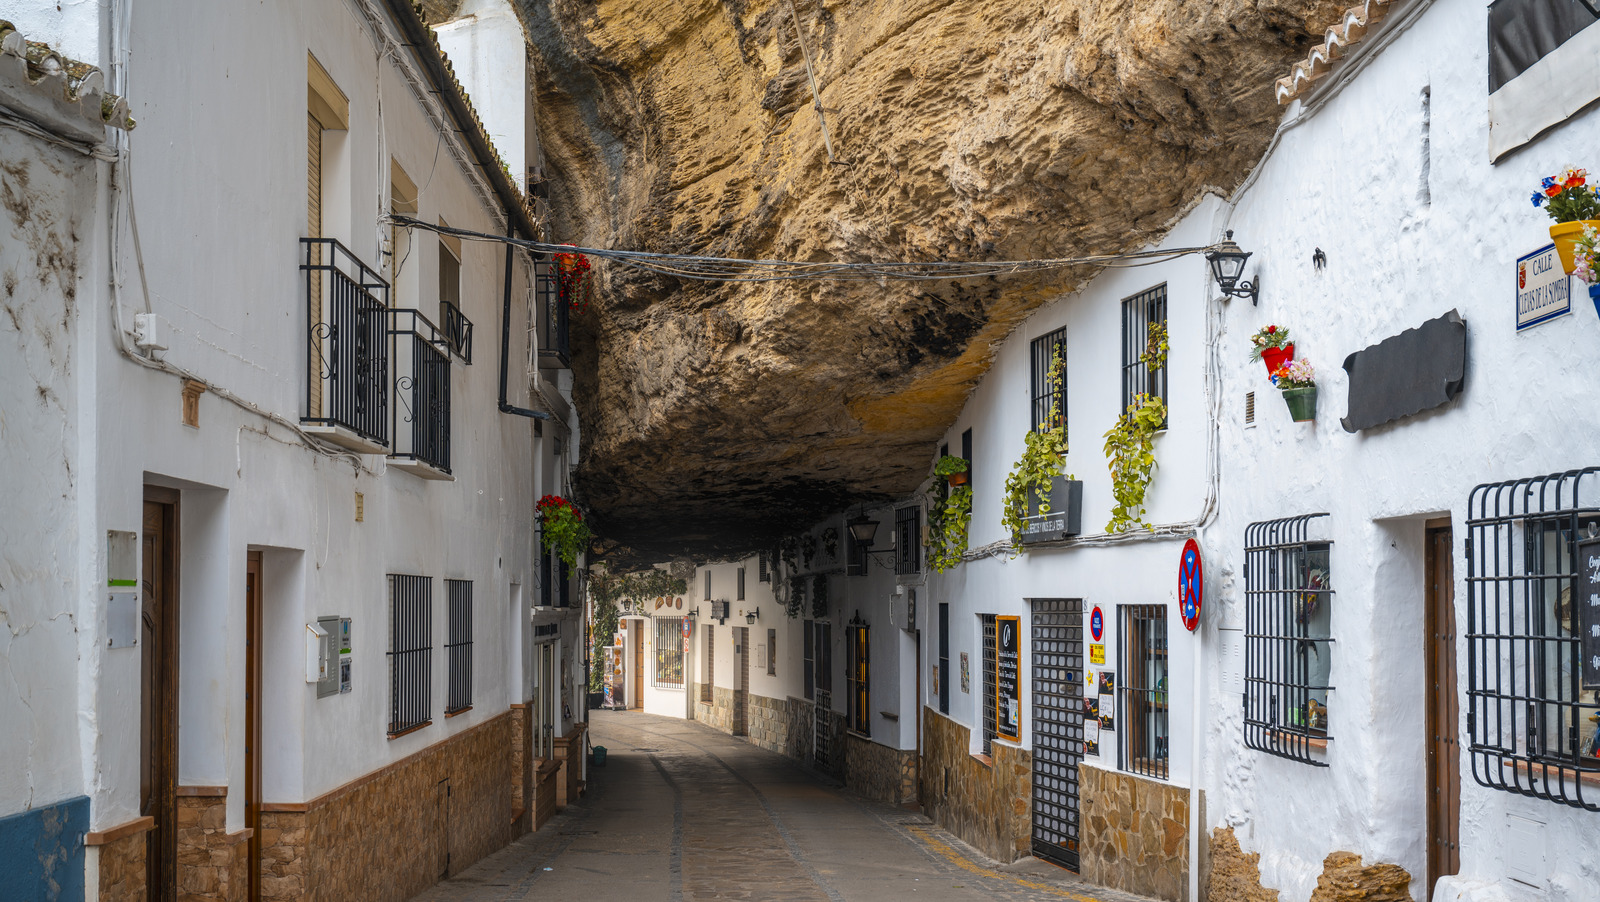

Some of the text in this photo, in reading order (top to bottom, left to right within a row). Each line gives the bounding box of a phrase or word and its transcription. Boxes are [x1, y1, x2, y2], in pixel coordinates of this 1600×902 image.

[1532, 254, 1553, 276] CALLE
[1519, 277, 1567, 315] CUEVAS DE LA SOMBRA
